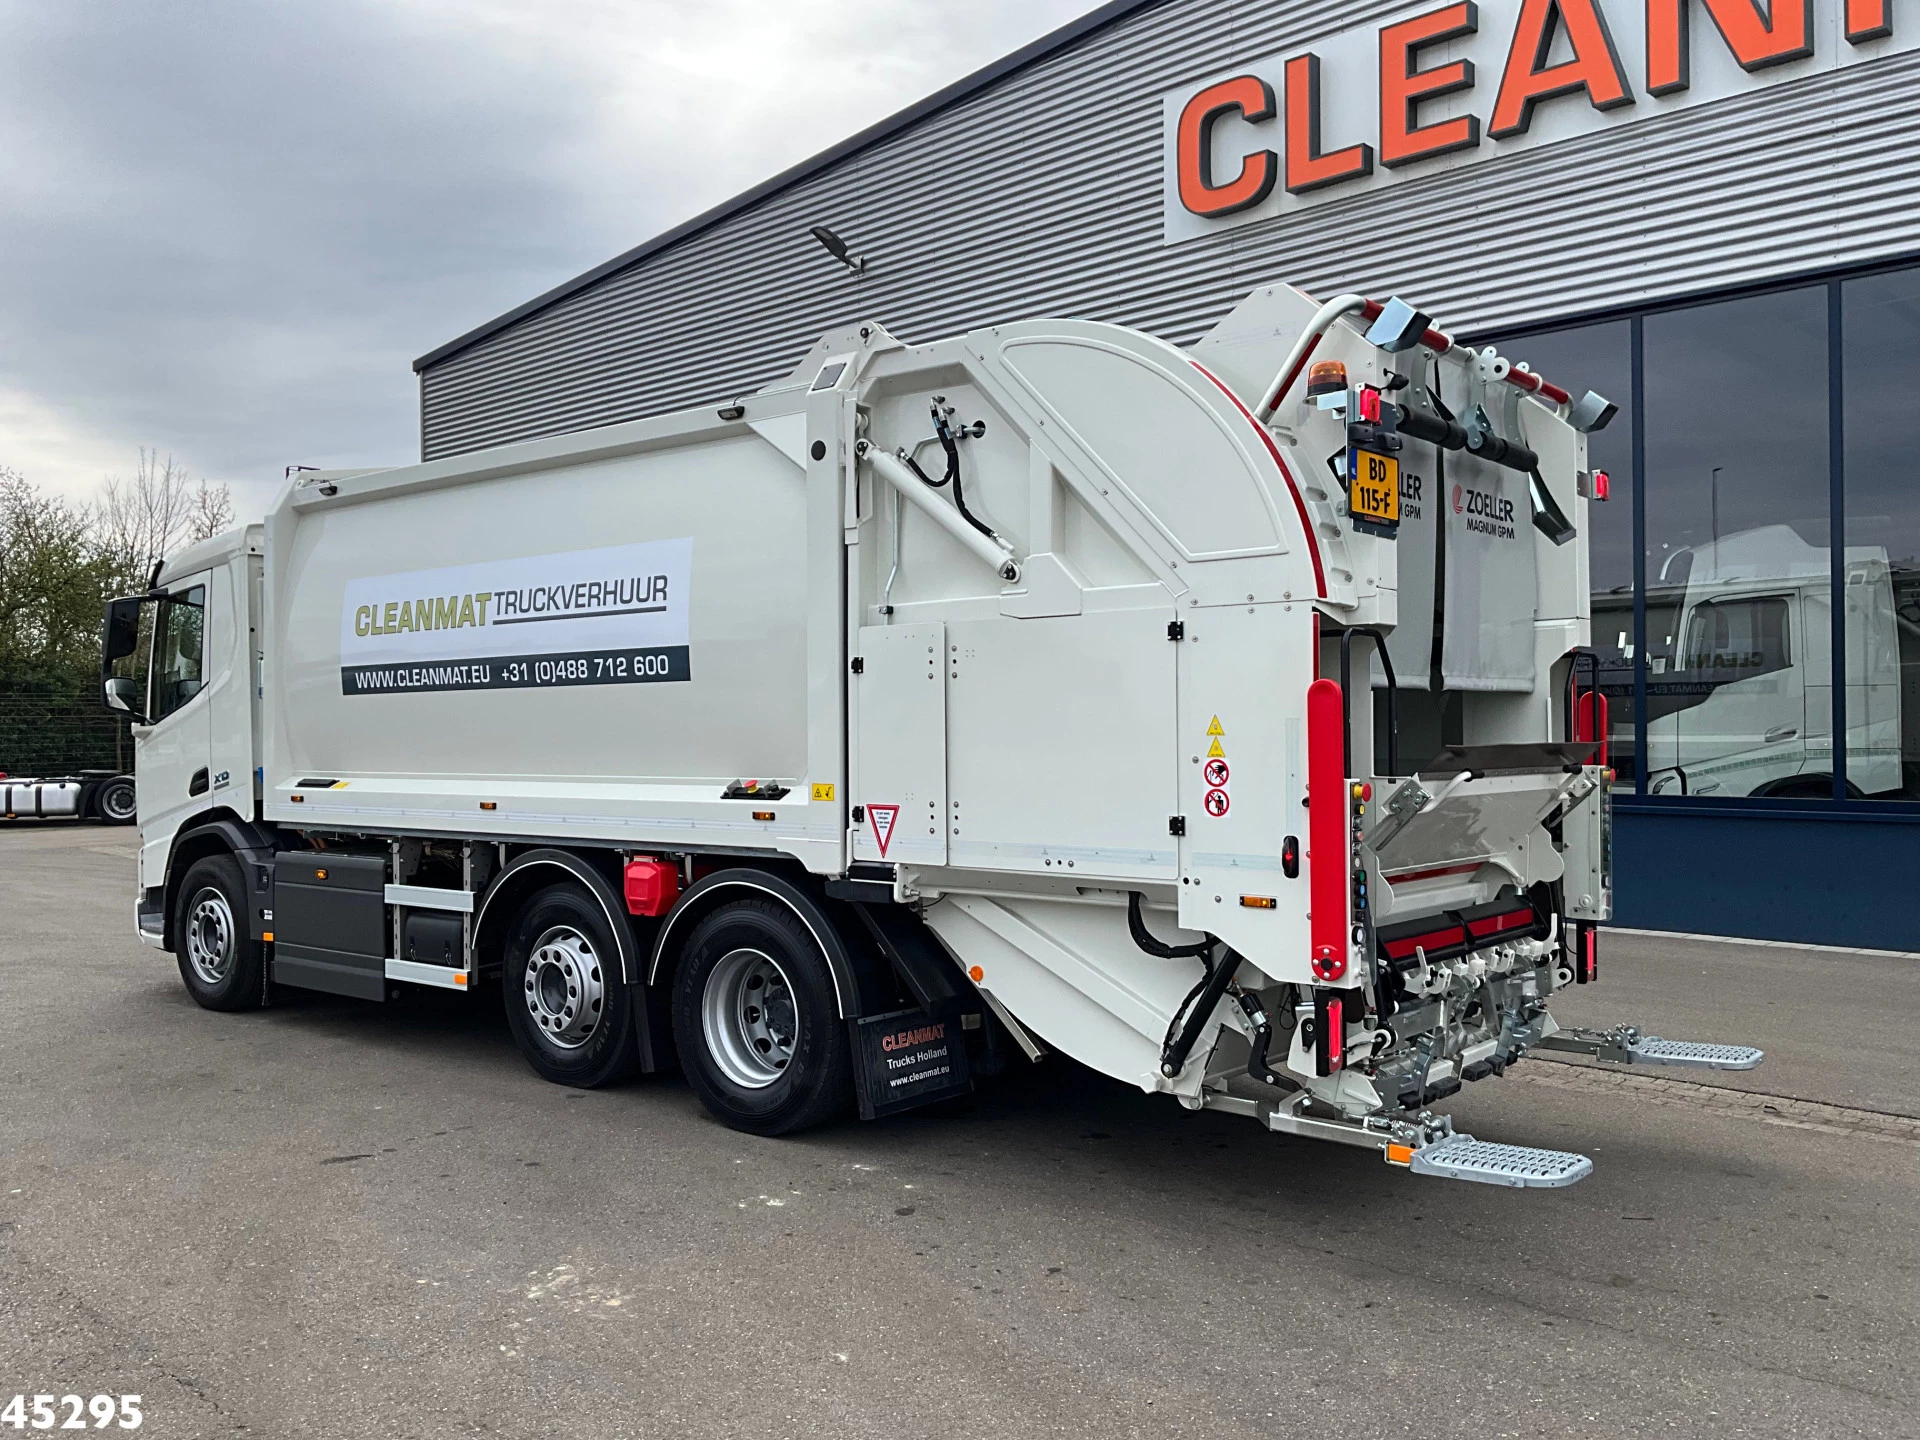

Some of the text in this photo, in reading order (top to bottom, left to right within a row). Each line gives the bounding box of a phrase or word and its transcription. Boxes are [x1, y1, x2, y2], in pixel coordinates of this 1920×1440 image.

[1369, 457, 1386, 482] BD
[1360, 486, 1390, 514] 115-F
[1466, 489, 1514, 522] ZOELLER
[1467, 518, 1515, 539] MAGNUM GPM
[355, 655, 669, 689] WWW.CLEANMAT.EU +31 (0)488 712 600
[882, 1024, 945, 1052] CLEANMAT
[887, 1046, 947, 1070] Trucks Holland
[890, 1065, 950, 1088] www.cleanmat.eu
